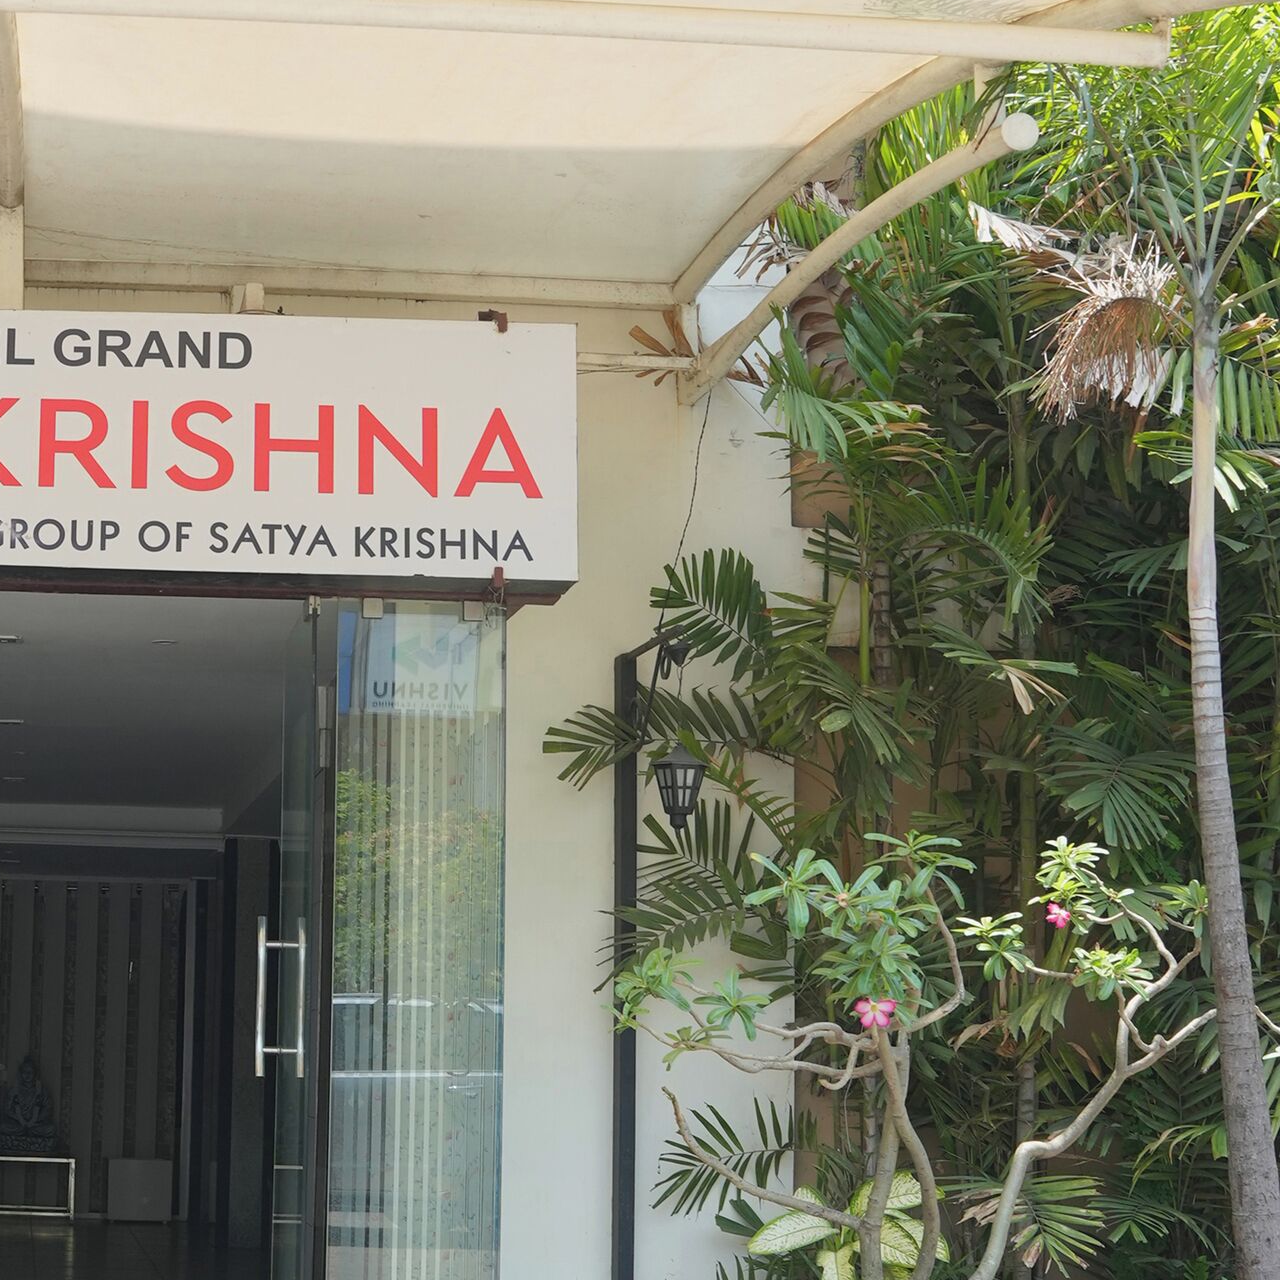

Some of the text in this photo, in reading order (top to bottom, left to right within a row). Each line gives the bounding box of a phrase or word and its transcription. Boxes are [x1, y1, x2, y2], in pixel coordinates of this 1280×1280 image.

[53, 328, 254, 370] GRAND
[137, 520, 193, 553] OF
[208, 521, 338, 558] SATYA
[354, 526, 534, 562] KRISHNA
